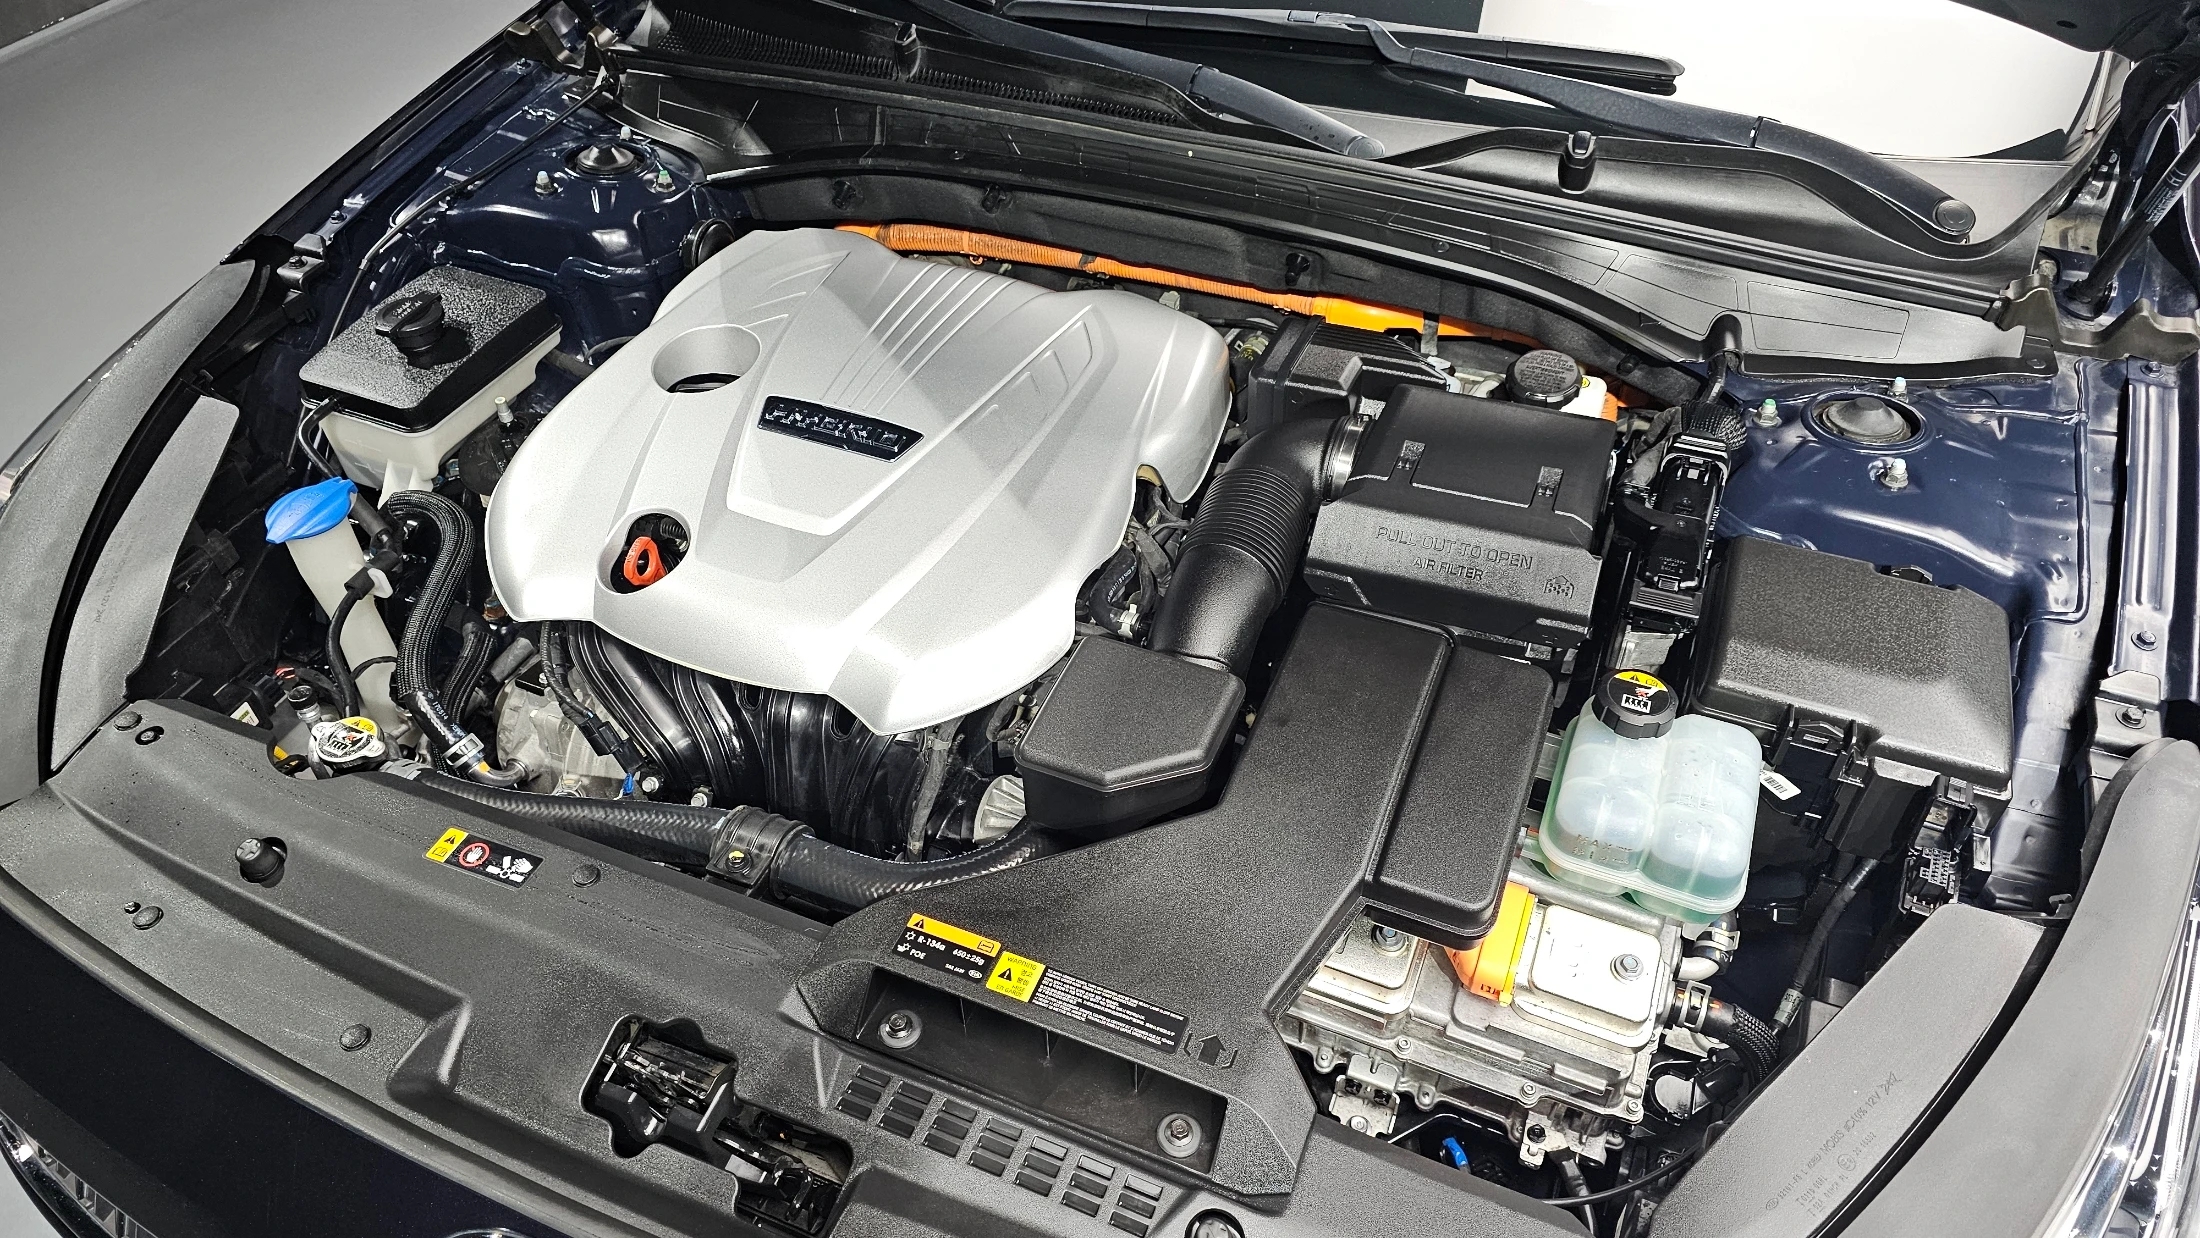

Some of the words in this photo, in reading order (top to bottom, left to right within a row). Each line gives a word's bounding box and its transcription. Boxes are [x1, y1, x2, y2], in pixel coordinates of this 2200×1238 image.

[1376, 526, 1417, 547] PULL
[1422, 534, 1455, 551] OUT
[1458, 542, 1482, 558] TO
[1486, 548, 1533, 570] OPEN
[1413, 556, 1436, 570] AIR
[1437, 562, 1484, 581] FILTER
[909, 947, 926, 960] POE
[1819, 1129, 1845, 1155] MOBIS
[1865, 1091, 1882, 1109] 12V
